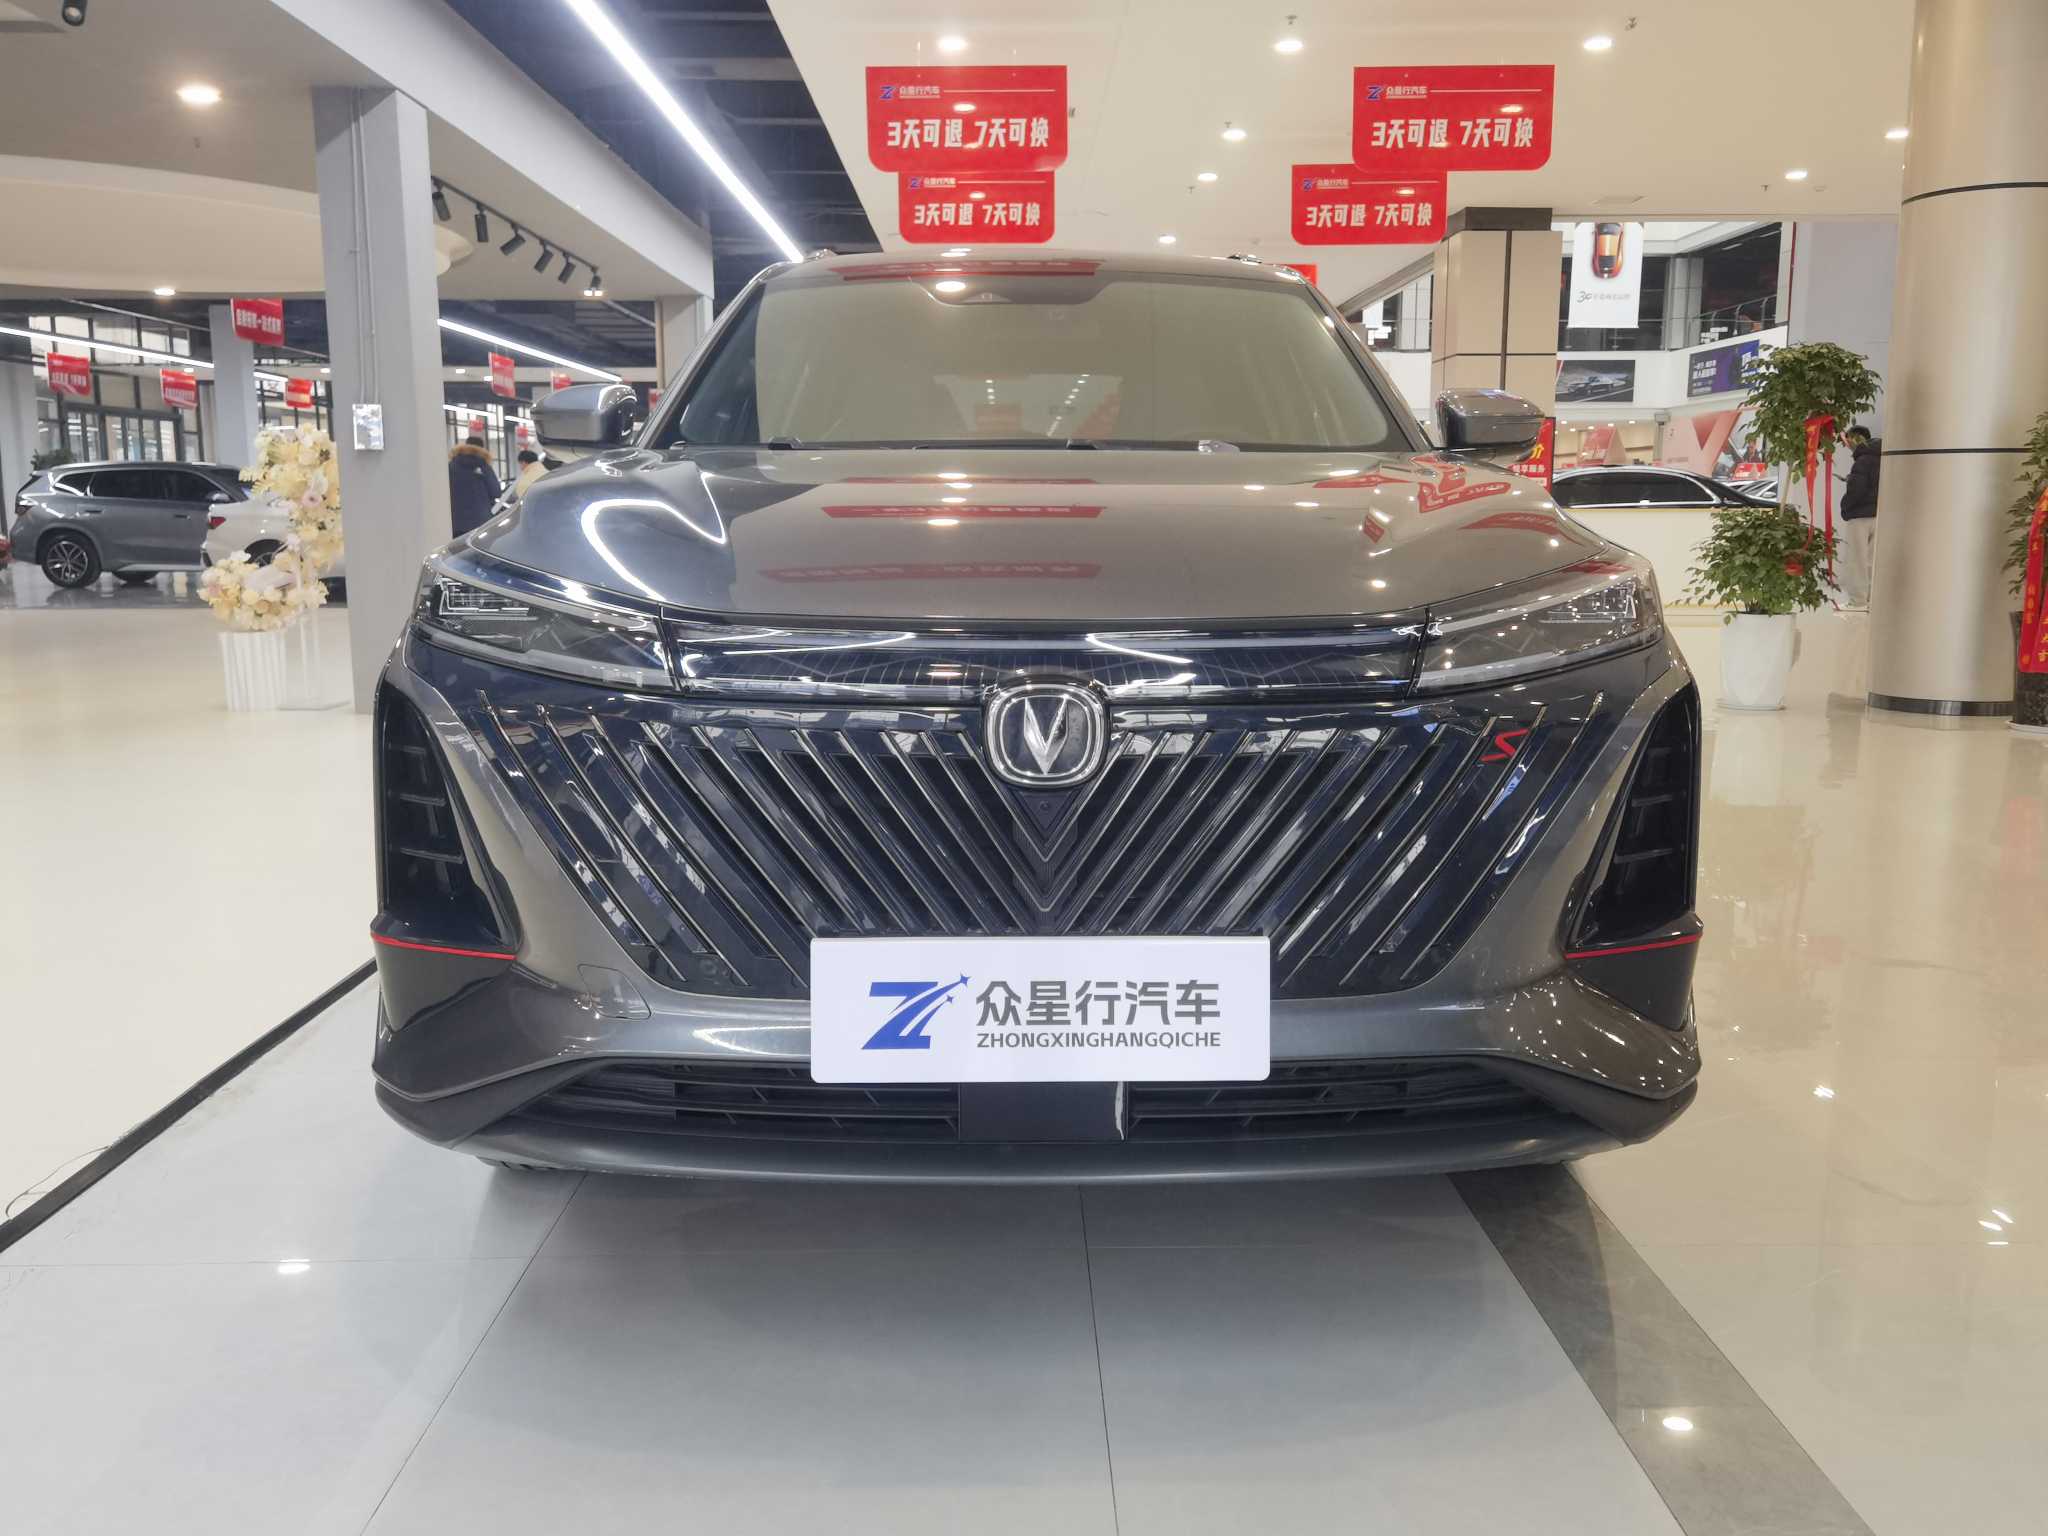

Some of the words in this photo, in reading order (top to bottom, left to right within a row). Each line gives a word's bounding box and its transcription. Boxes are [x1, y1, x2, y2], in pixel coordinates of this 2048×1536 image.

[887, 118, 964, 148] 3天可退
[974, 117, 1049, 148] 7天可换
[1371, 118, 1449, 149] 3天可退
[1459, 117, 1534, 148] 7天可换
[914, 202, 974, 227] 3天可退
[982, 202, 1041, 227] 7天可换
[1305, 204, 1367, 228] 3天可退
[1375, 202, 1433, 227] 7天可换
[975, 979, 1222, 1027] 众星行汽车
[976, 1031, 1222, 1049] ZHONGXINGHANGQICHE
